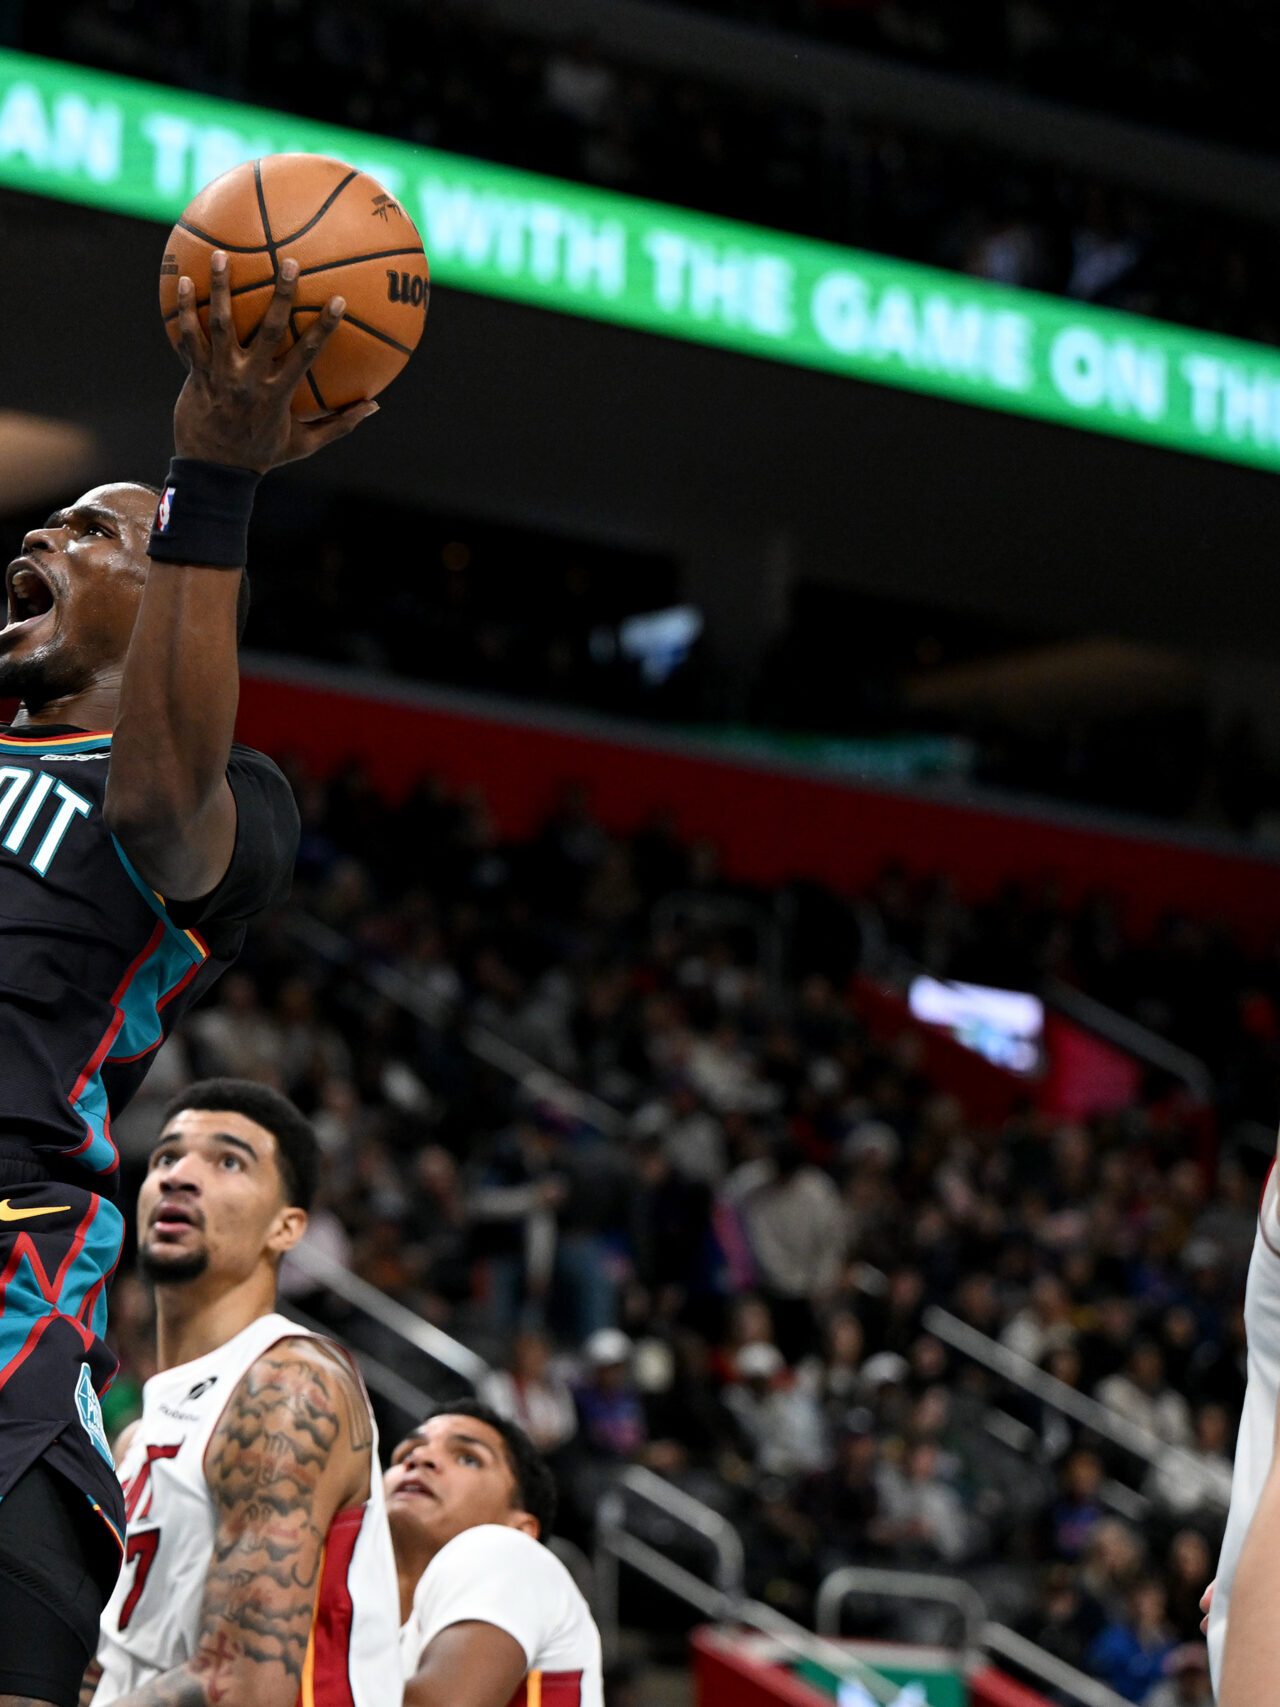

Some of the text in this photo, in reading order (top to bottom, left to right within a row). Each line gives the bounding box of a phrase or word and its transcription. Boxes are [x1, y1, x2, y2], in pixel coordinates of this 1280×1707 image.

[417, 178, 627, 298] WITH
[643, 229, 795, 337] THE
[810, 270, 1035, 392] GAME
[1049, 325, 1168, 421] ON
[1180, 353, 1280, 448] TH
[117, 1526, 162, 1632] 7
